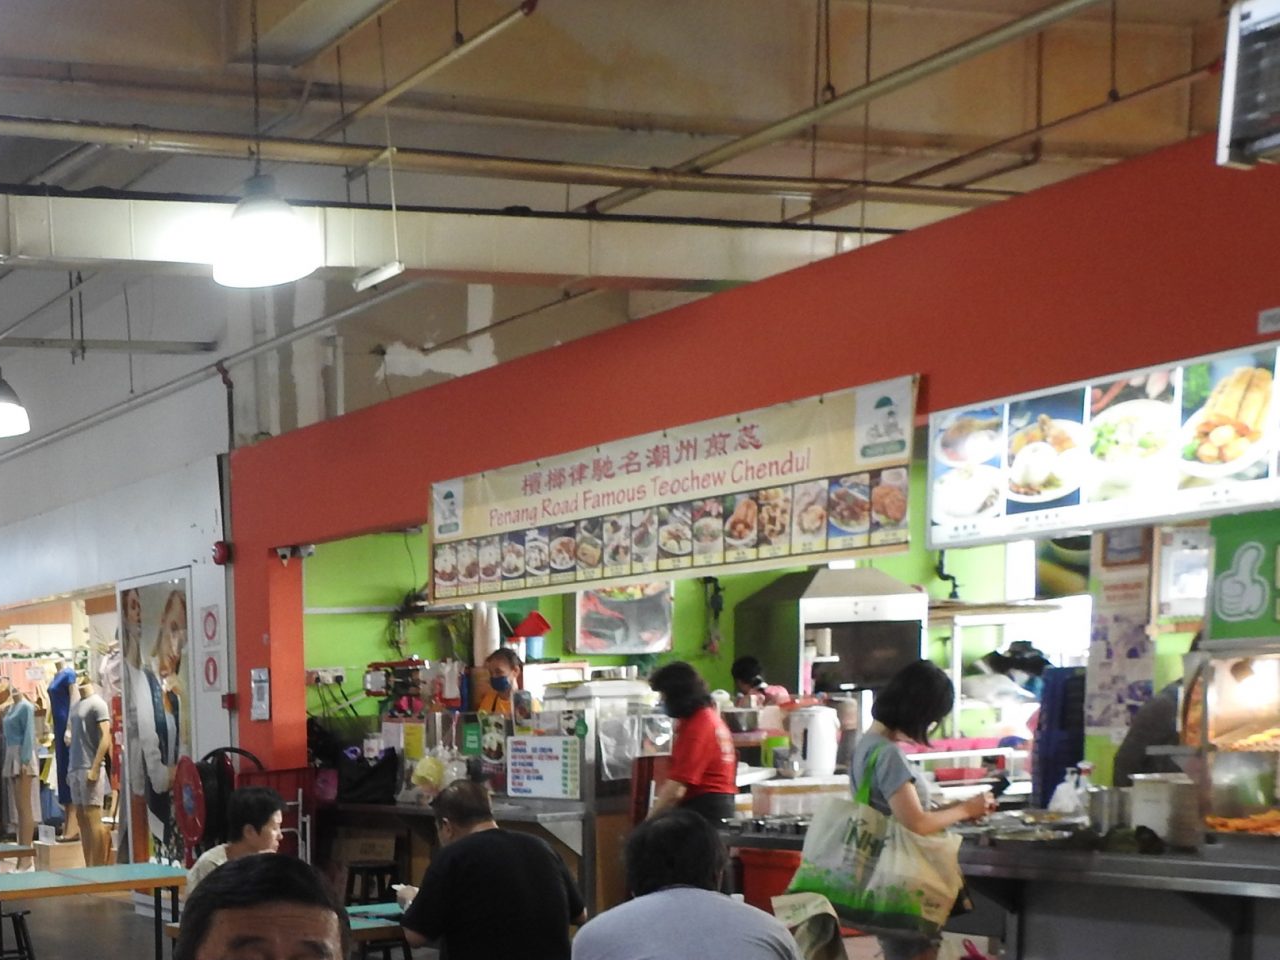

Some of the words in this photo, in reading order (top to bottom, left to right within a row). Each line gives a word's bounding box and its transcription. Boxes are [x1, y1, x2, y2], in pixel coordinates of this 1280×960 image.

[489, 505, 538, 528] Penang
[541, 491, 579, 519] Road
[582, 483, 647, 511] Famous
[650, 468, 727, 497] Teochew
[731, 446, 812, 485] Chendul
